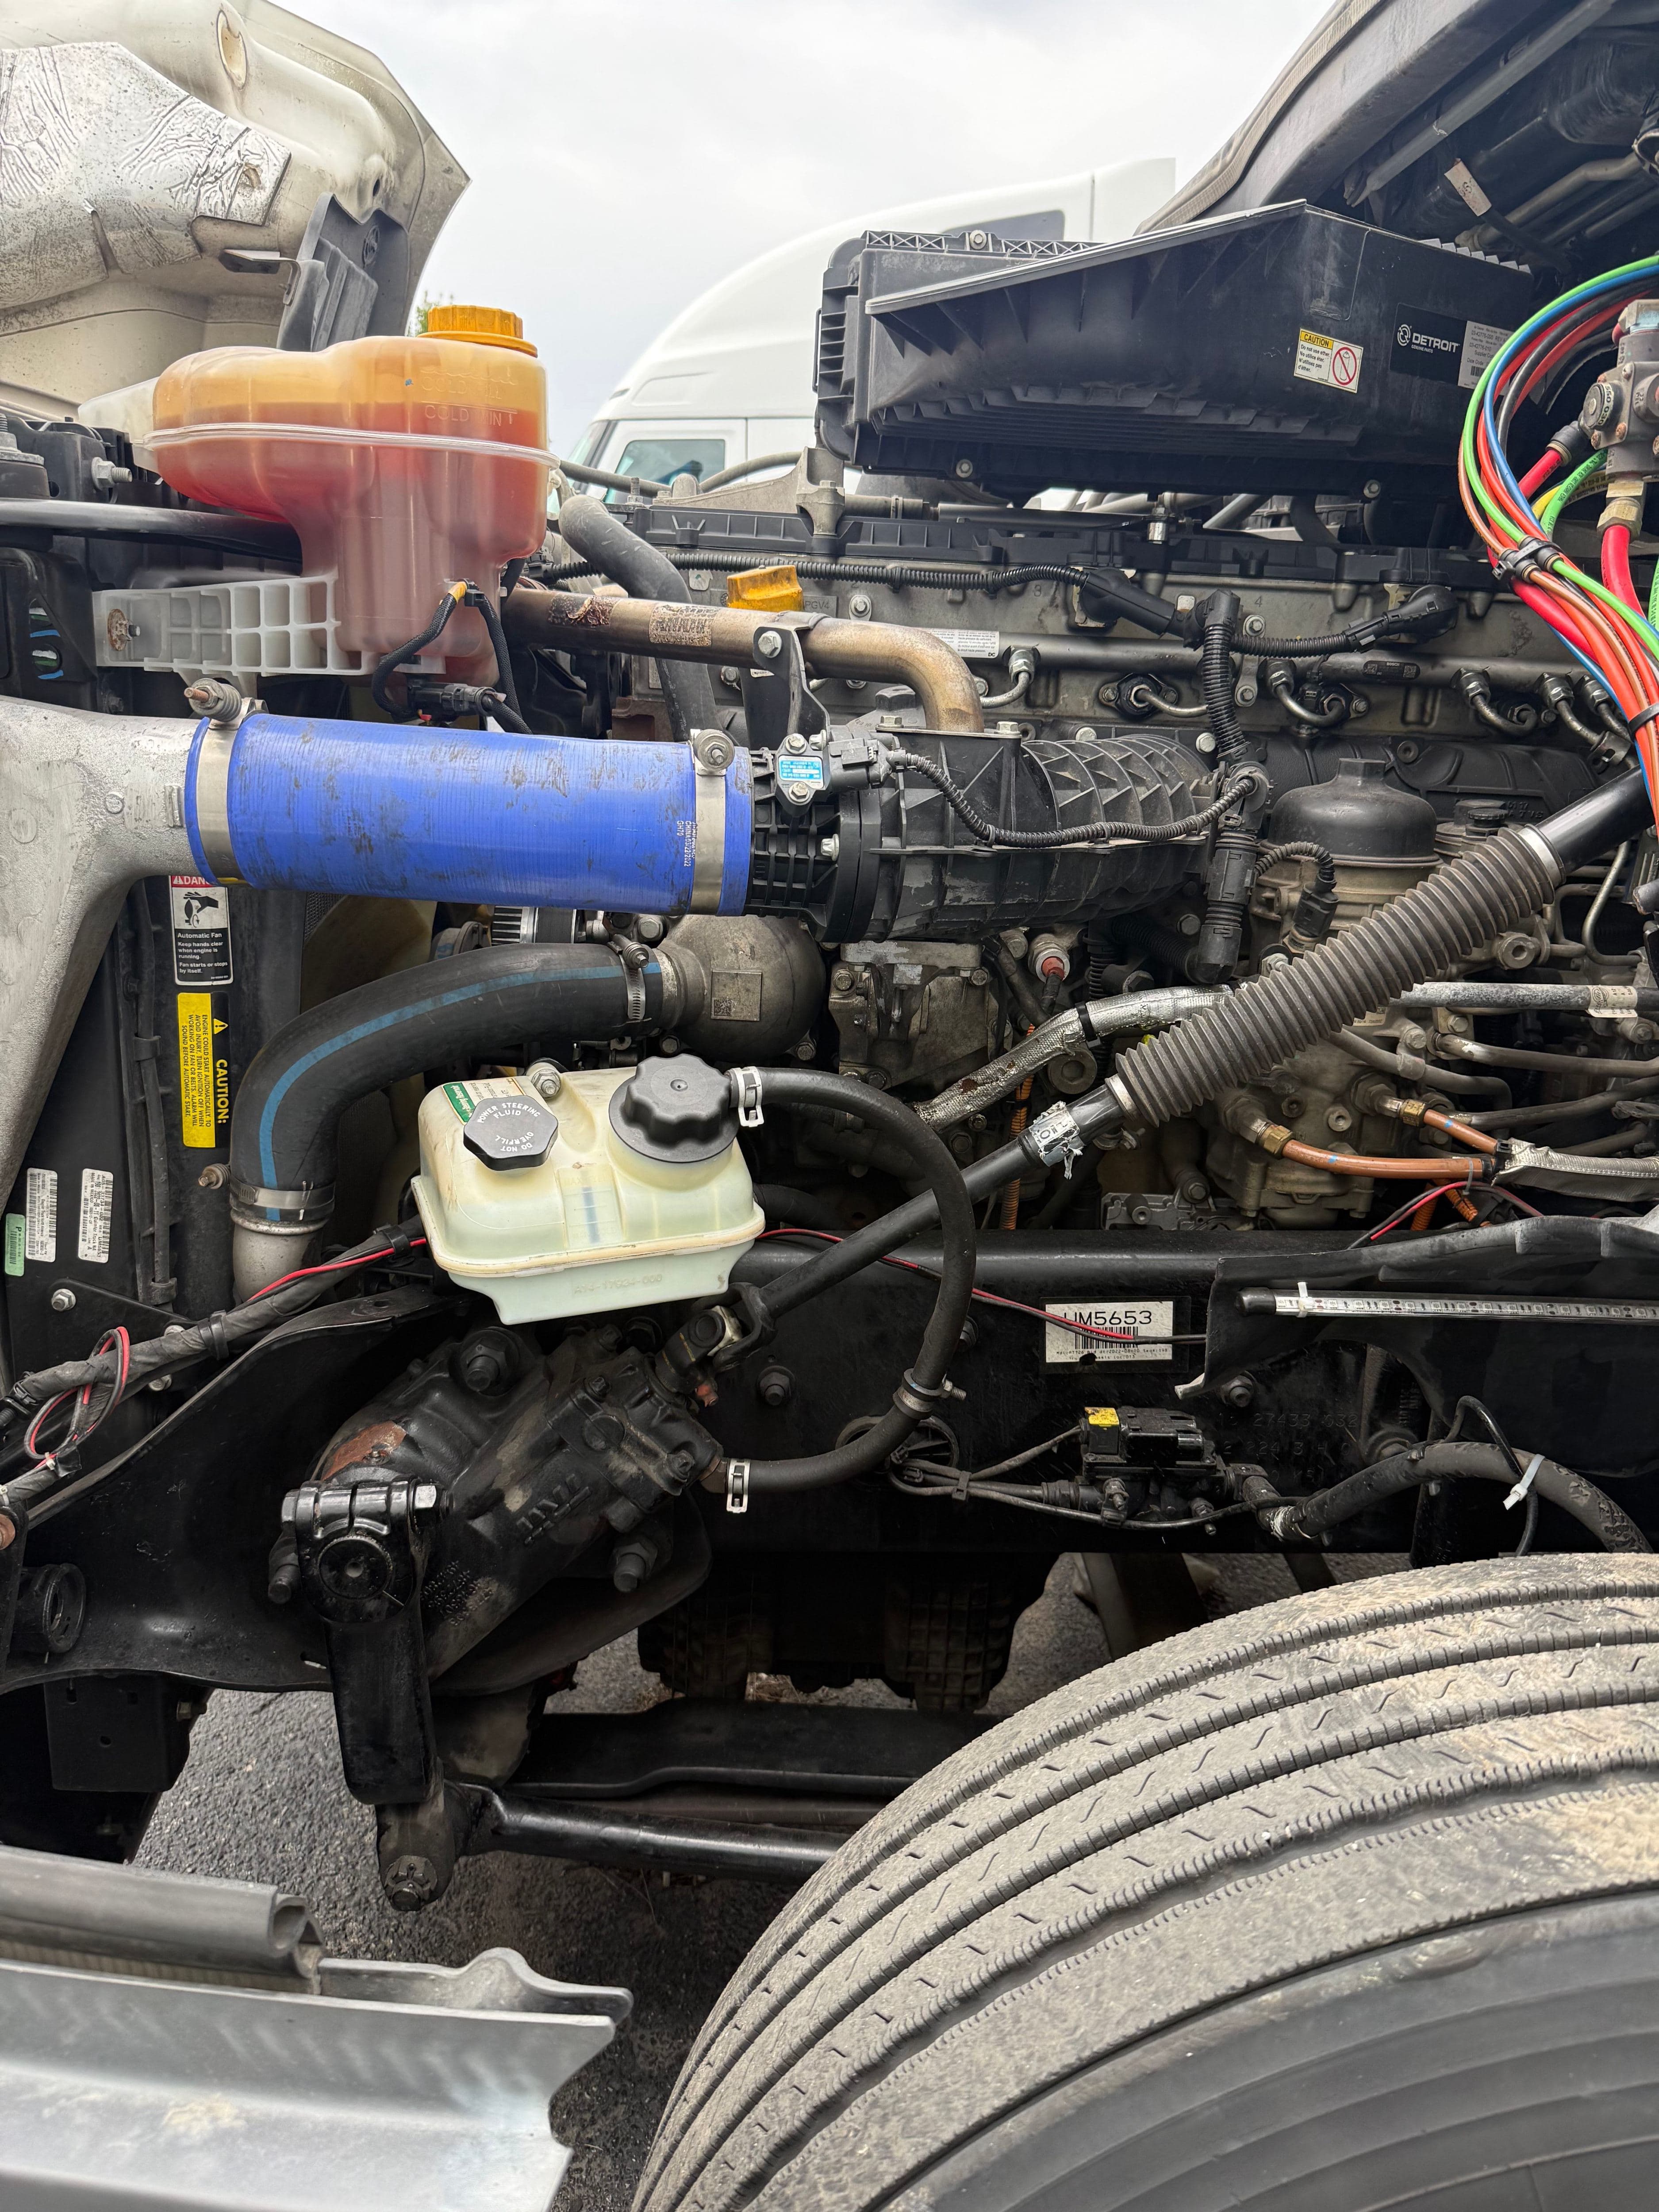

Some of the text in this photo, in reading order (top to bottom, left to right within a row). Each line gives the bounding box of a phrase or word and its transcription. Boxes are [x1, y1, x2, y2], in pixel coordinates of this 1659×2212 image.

[1304, 334, 1329, 347] CAUTION
[1412, 333, 1459, 353] DETROIT
[422, 376, 467, 394] COLD
[425, 405, 469, 421] COLD
[1598, 406, 1609, 425] 030
[1255, 595, 1263, 607] 4
[189, 1044, 195, 1053] ON
[216, 1059, 229, 1124] CAUTION:
[477, 1105, 499, 1124] POWER
[502, 1102, 541, 1118] STEERING
[493, 1109, 522, 1119] FLUID
[495, 1131, 534, 1145] OVERFILL
[521, 1142, 533, 1151] DO
[1253, 1413, 1311, 1427] 27433
